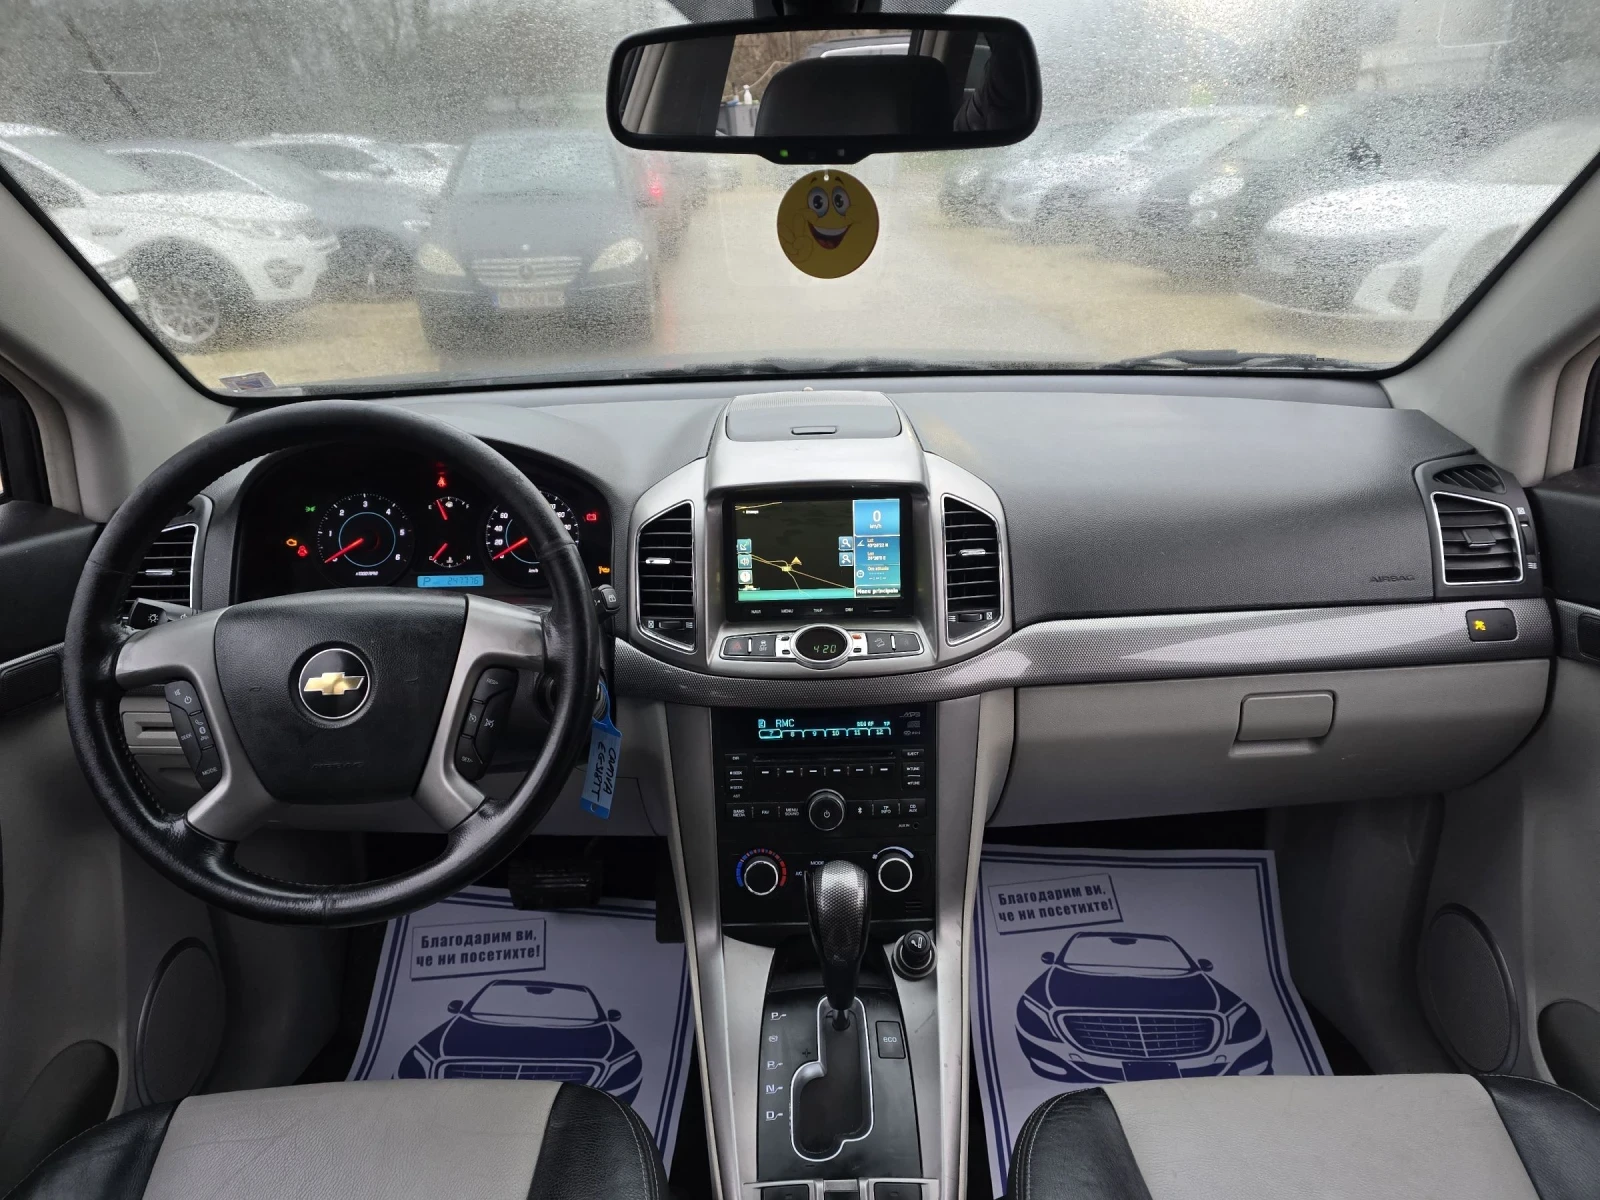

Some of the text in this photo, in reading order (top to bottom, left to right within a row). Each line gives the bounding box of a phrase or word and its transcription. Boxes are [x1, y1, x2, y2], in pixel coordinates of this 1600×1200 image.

[873, 510, 881, 522] 0
[423, 577, 431, 586] P
[1370, 574, 1415, 583] AIRBAG
[776, 719, 795, 728] RMC
[202, 767, 218, 776] MODE
[998, 884, 1106, 905] Благодарим ви,
[998, 898, 1114, 922] че ни посетихте!
[421, 930, 536, 949] Благодарим ви,
[416, 945, 540, 967] че ни посетихте!
